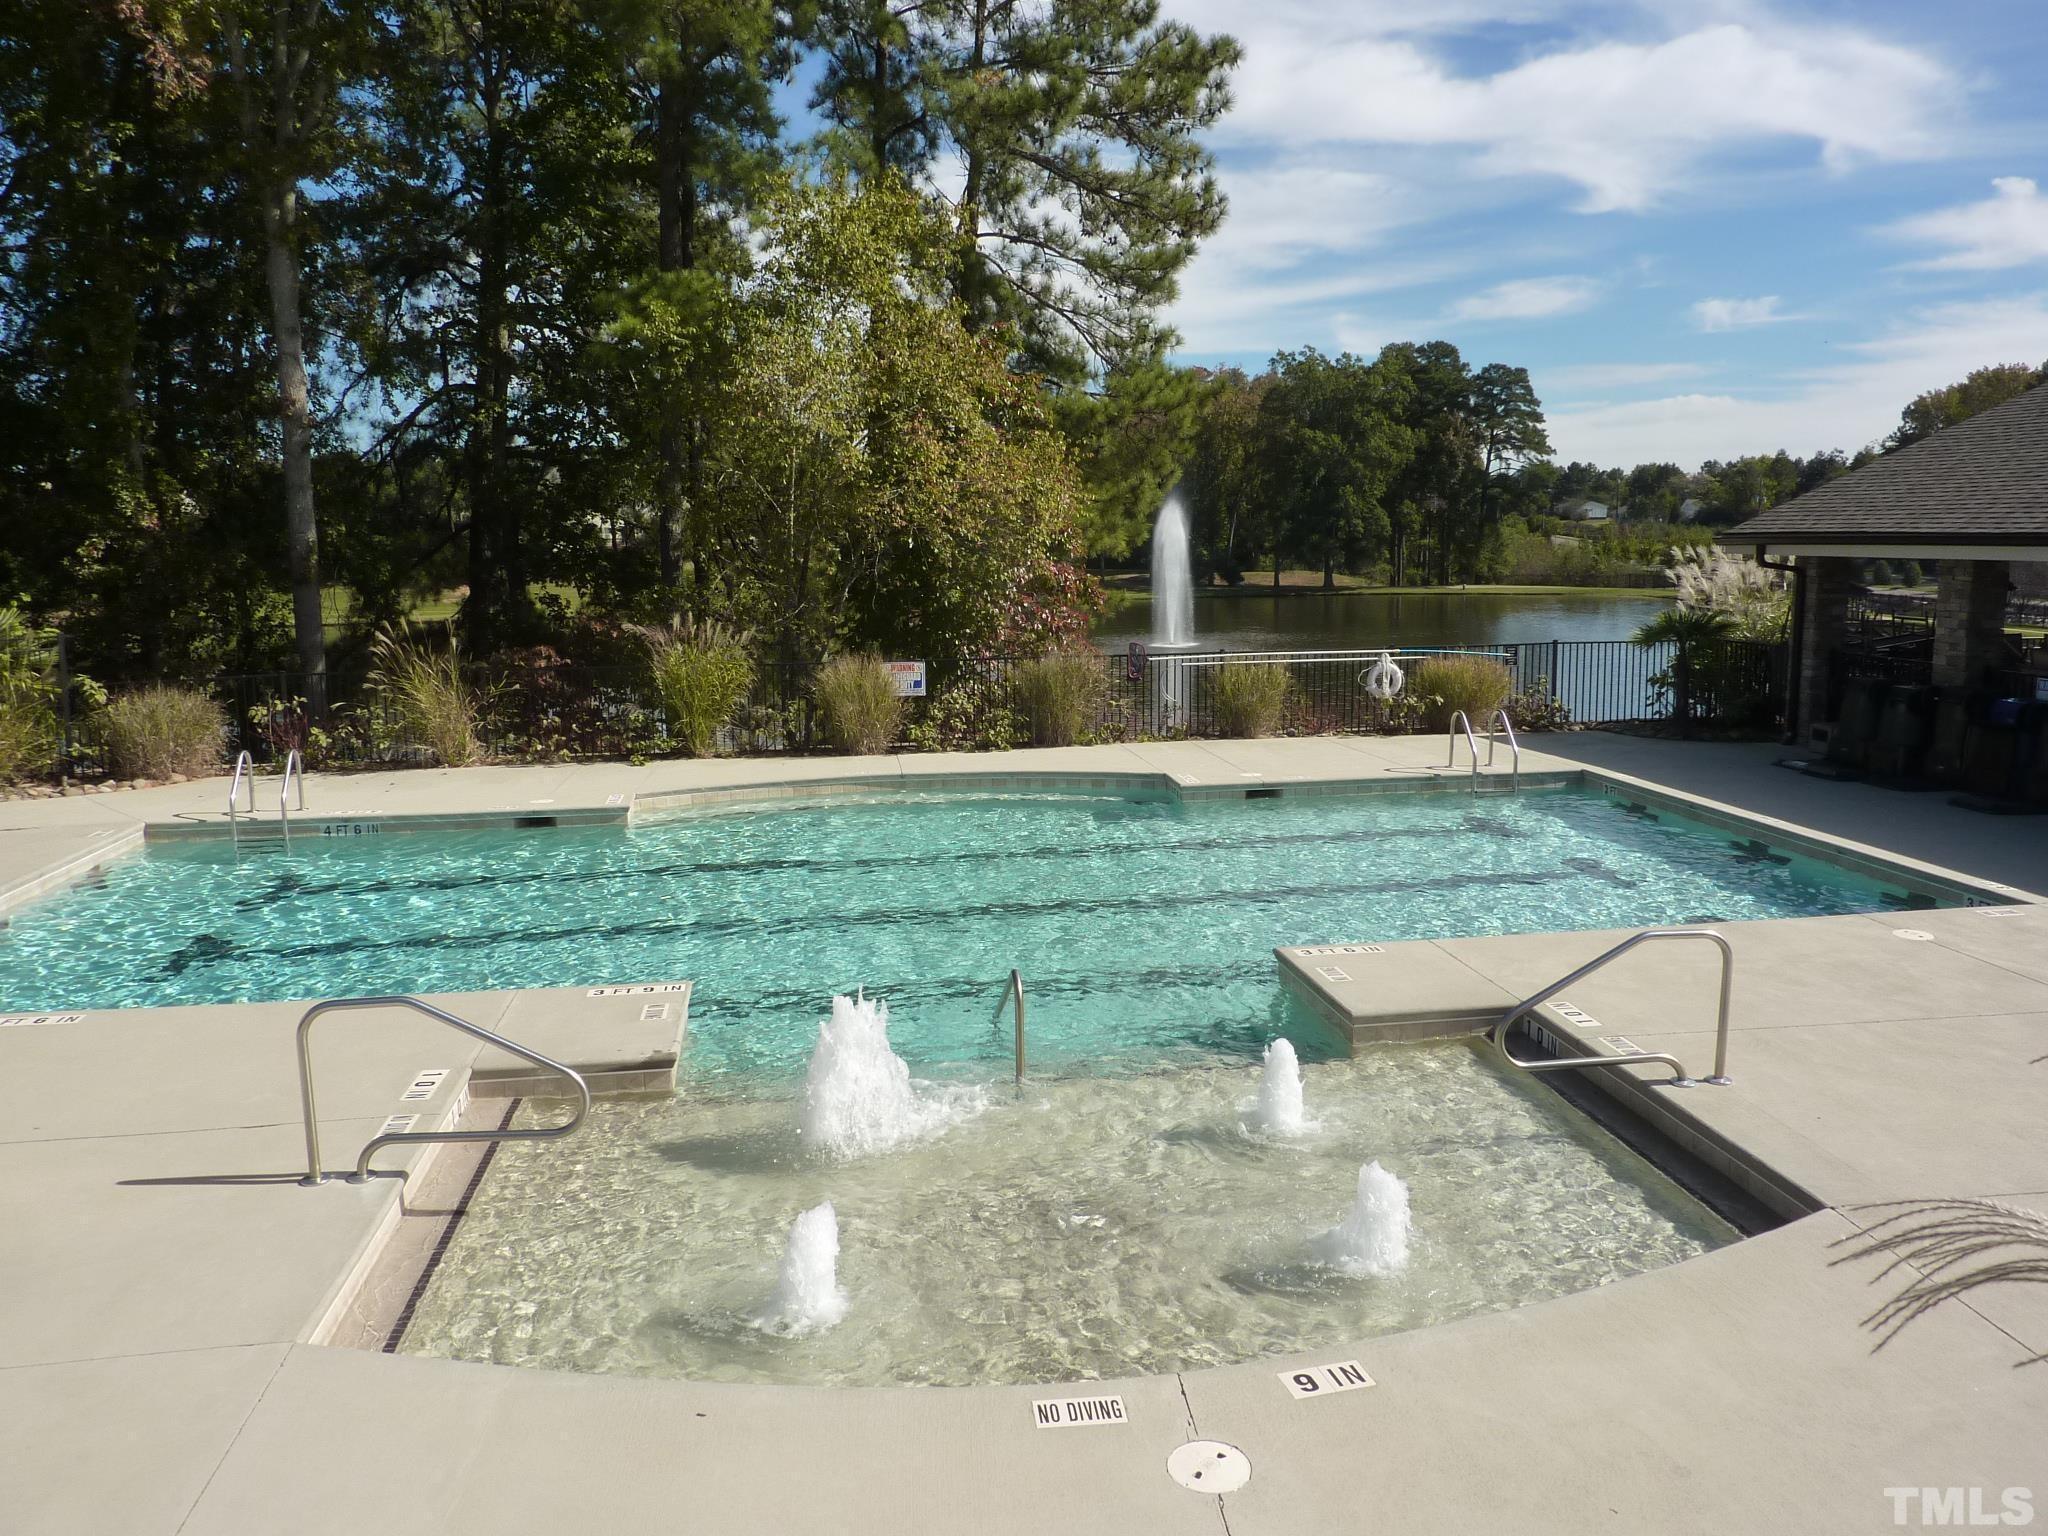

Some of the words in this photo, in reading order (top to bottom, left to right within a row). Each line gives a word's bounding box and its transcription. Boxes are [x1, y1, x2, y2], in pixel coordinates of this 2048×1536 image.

[323, 825, 332, 836] 4
[336, 824, 348, 835] FT
[353, 824, 362, 835] 6
[367, 823, 379, 834] IN
[663, 984, 682, 992] IN
[1, 1018, 29, 1026] FT
[1292, 1373, 1320, 1393] 9
[1326, 1364, 1367, 1388] IN
[1037, 1403, 1061, 1424] NO
[1066, 1399, 1123, 1422] DIVING
